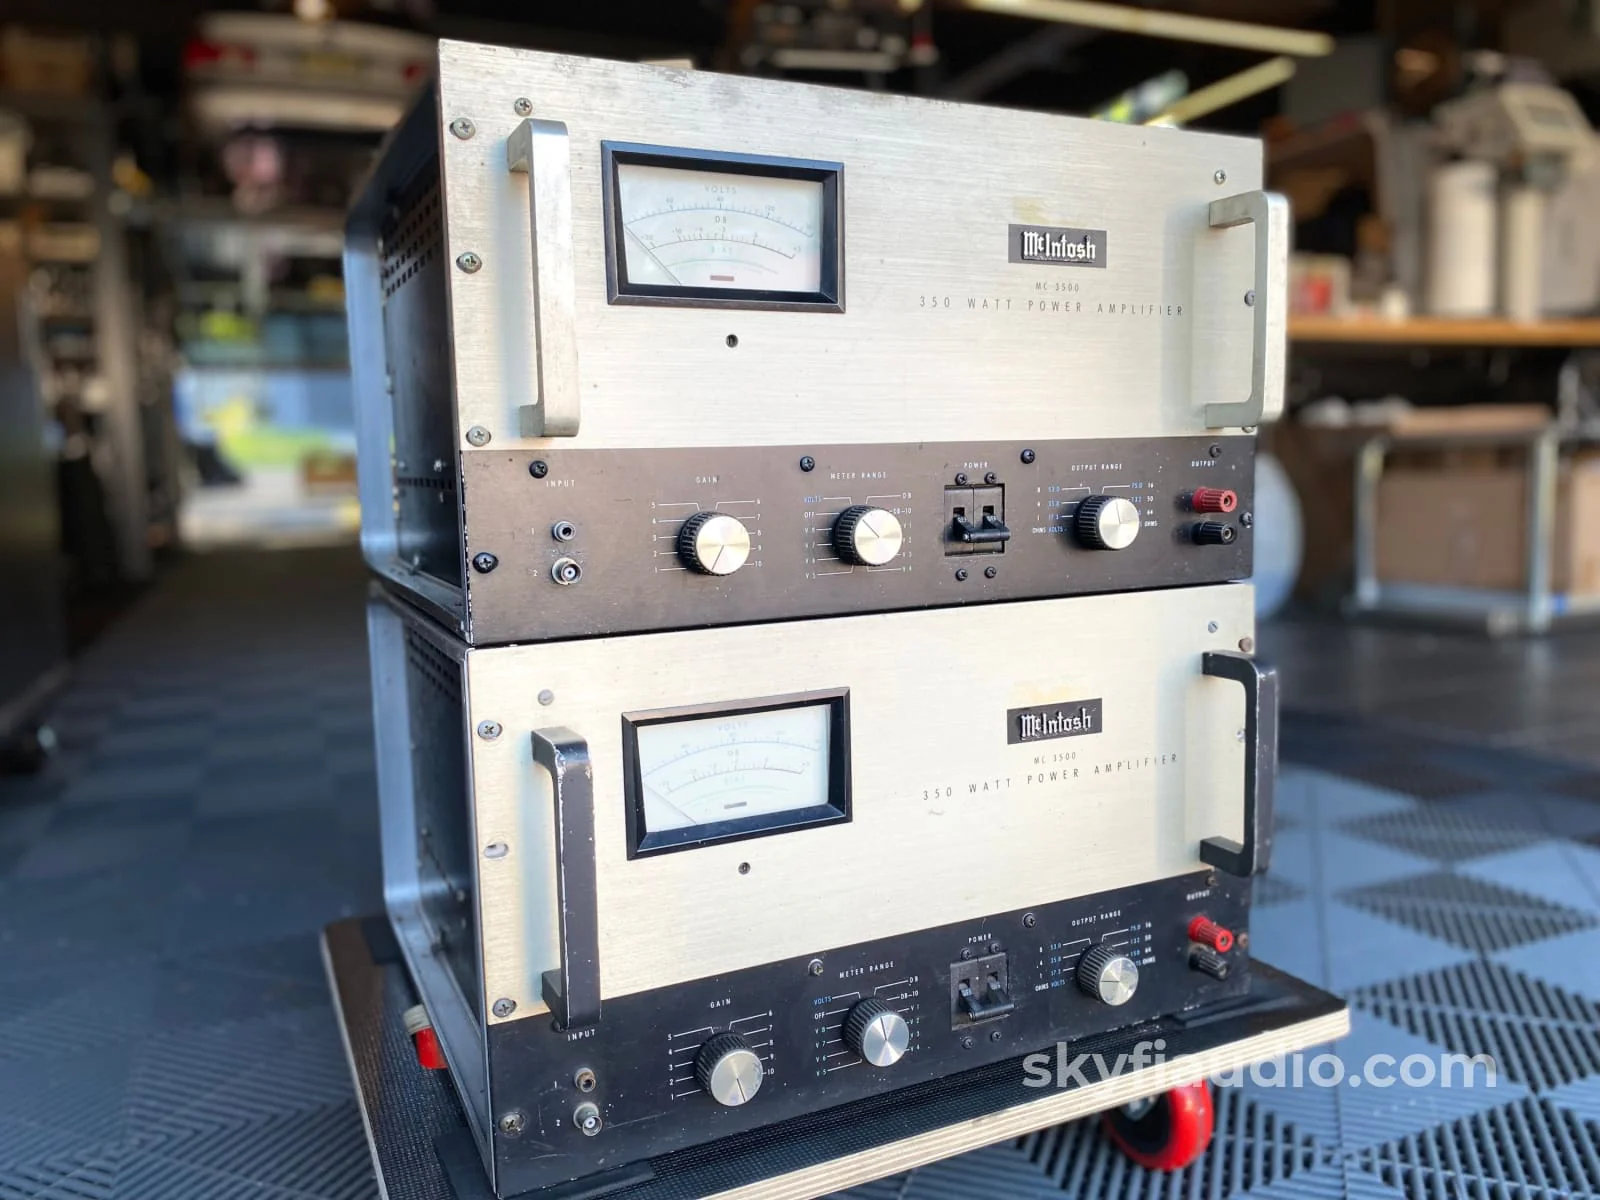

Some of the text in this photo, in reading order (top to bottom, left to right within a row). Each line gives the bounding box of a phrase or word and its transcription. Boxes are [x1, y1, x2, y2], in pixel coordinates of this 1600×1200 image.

[704, 184, 737, 195] VOLTS
[1022, 231, 1096, 261] McIntosh
[1035, 282, 1080, 292] MC 3500
[919, 296, 1183, 316] 350 WATT POWER AMPLIFIER
[1020, 706, 1092, 740] McIntosh
[1033, 752, 1077, 765] MC 3500
[923, 753, 1178, 800] 350 WATT POWER AMPLIFIER
[1072, 910, 1121, 926] OUTPUT RANGE
[968, 933, 992, 943] POWER
[840, 961, 894, 978] METER RANGE
[710, 998, 731, 1008] GAIN
[814, 996, 832, 1005] VOLTS
[567, 1029, 595, 1041] INPUT
